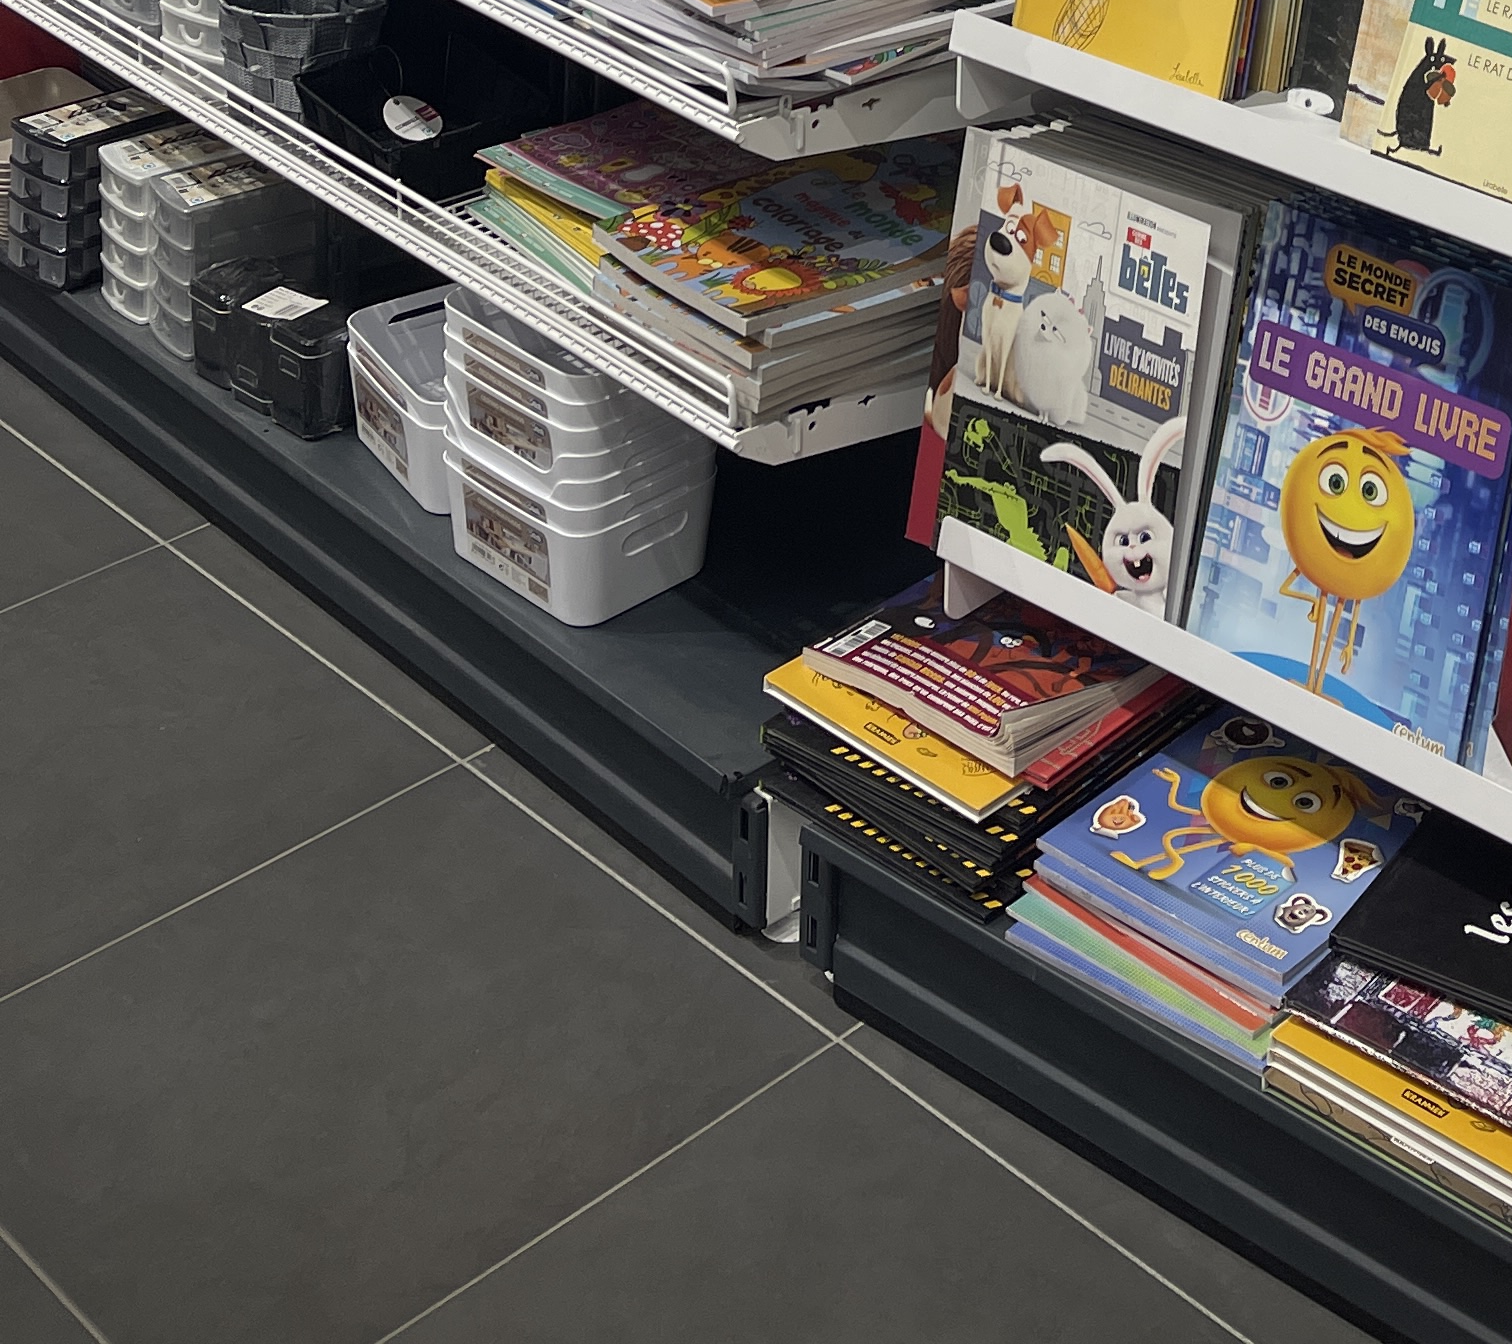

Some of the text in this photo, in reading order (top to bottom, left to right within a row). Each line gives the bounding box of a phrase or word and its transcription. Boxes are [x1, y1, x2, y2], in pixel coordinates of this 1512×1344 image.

[1486, 0, 1498, 15] LE
[1467, 53, 1481, 70] LE
[1482, 58, 1505, 78] RAT
[751, 196, 847, 255] coloriage
[1332, 267, 1410, 308] SECRET
[1364, 314, 1442, 356] DES EMOJIS
[1108, 361, 1172, 412] DÉLIRANTES
[1259, 330, 1502, 463] LE GRAND LIVRE
